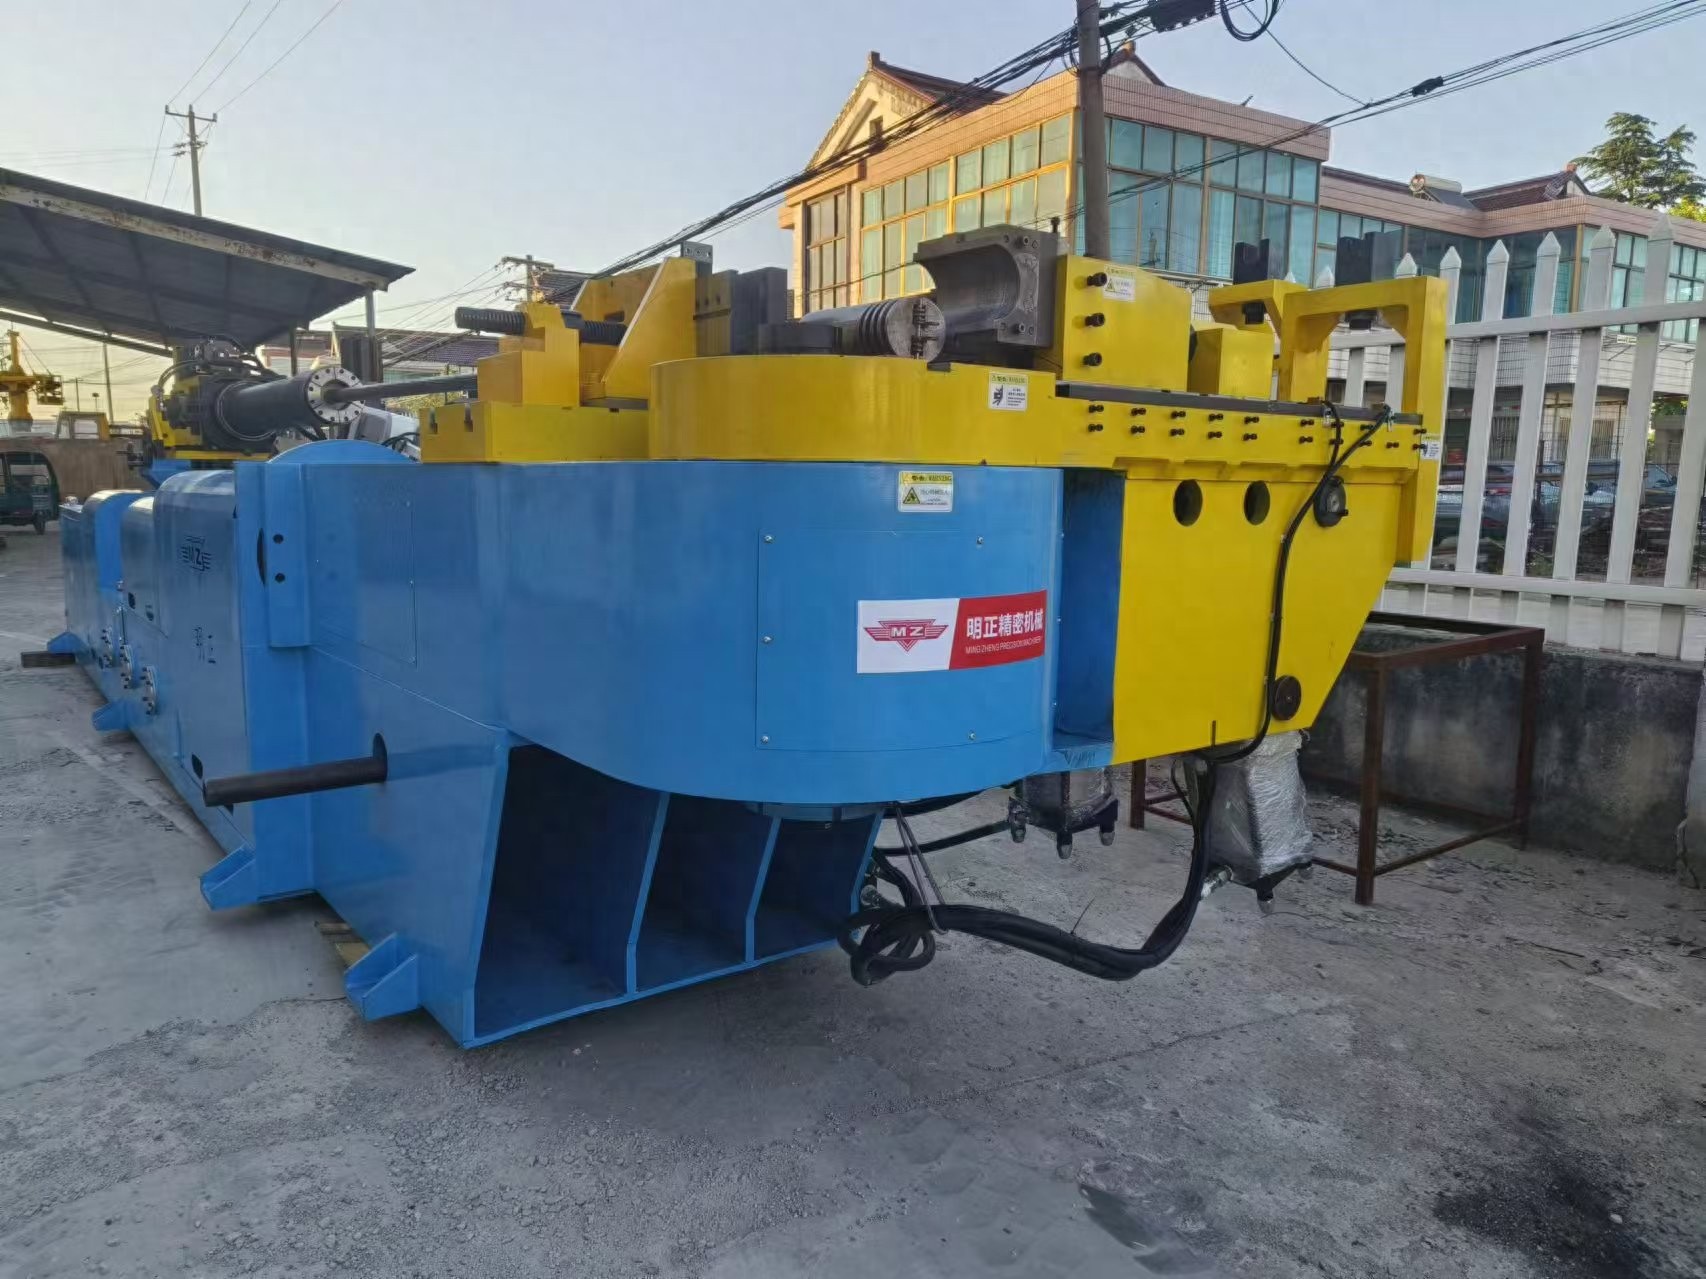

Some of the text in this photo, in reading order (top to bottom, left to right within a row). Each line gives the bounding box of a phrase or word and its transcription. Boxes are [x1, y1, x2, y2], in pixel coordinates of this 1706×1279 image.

[966, 609, 1043, 639] 明正精密机械
[891, 626, 925, 637] MZ
[965, 644, 981, 655] MING
[981, 641, 1000, 653] ZHENG
